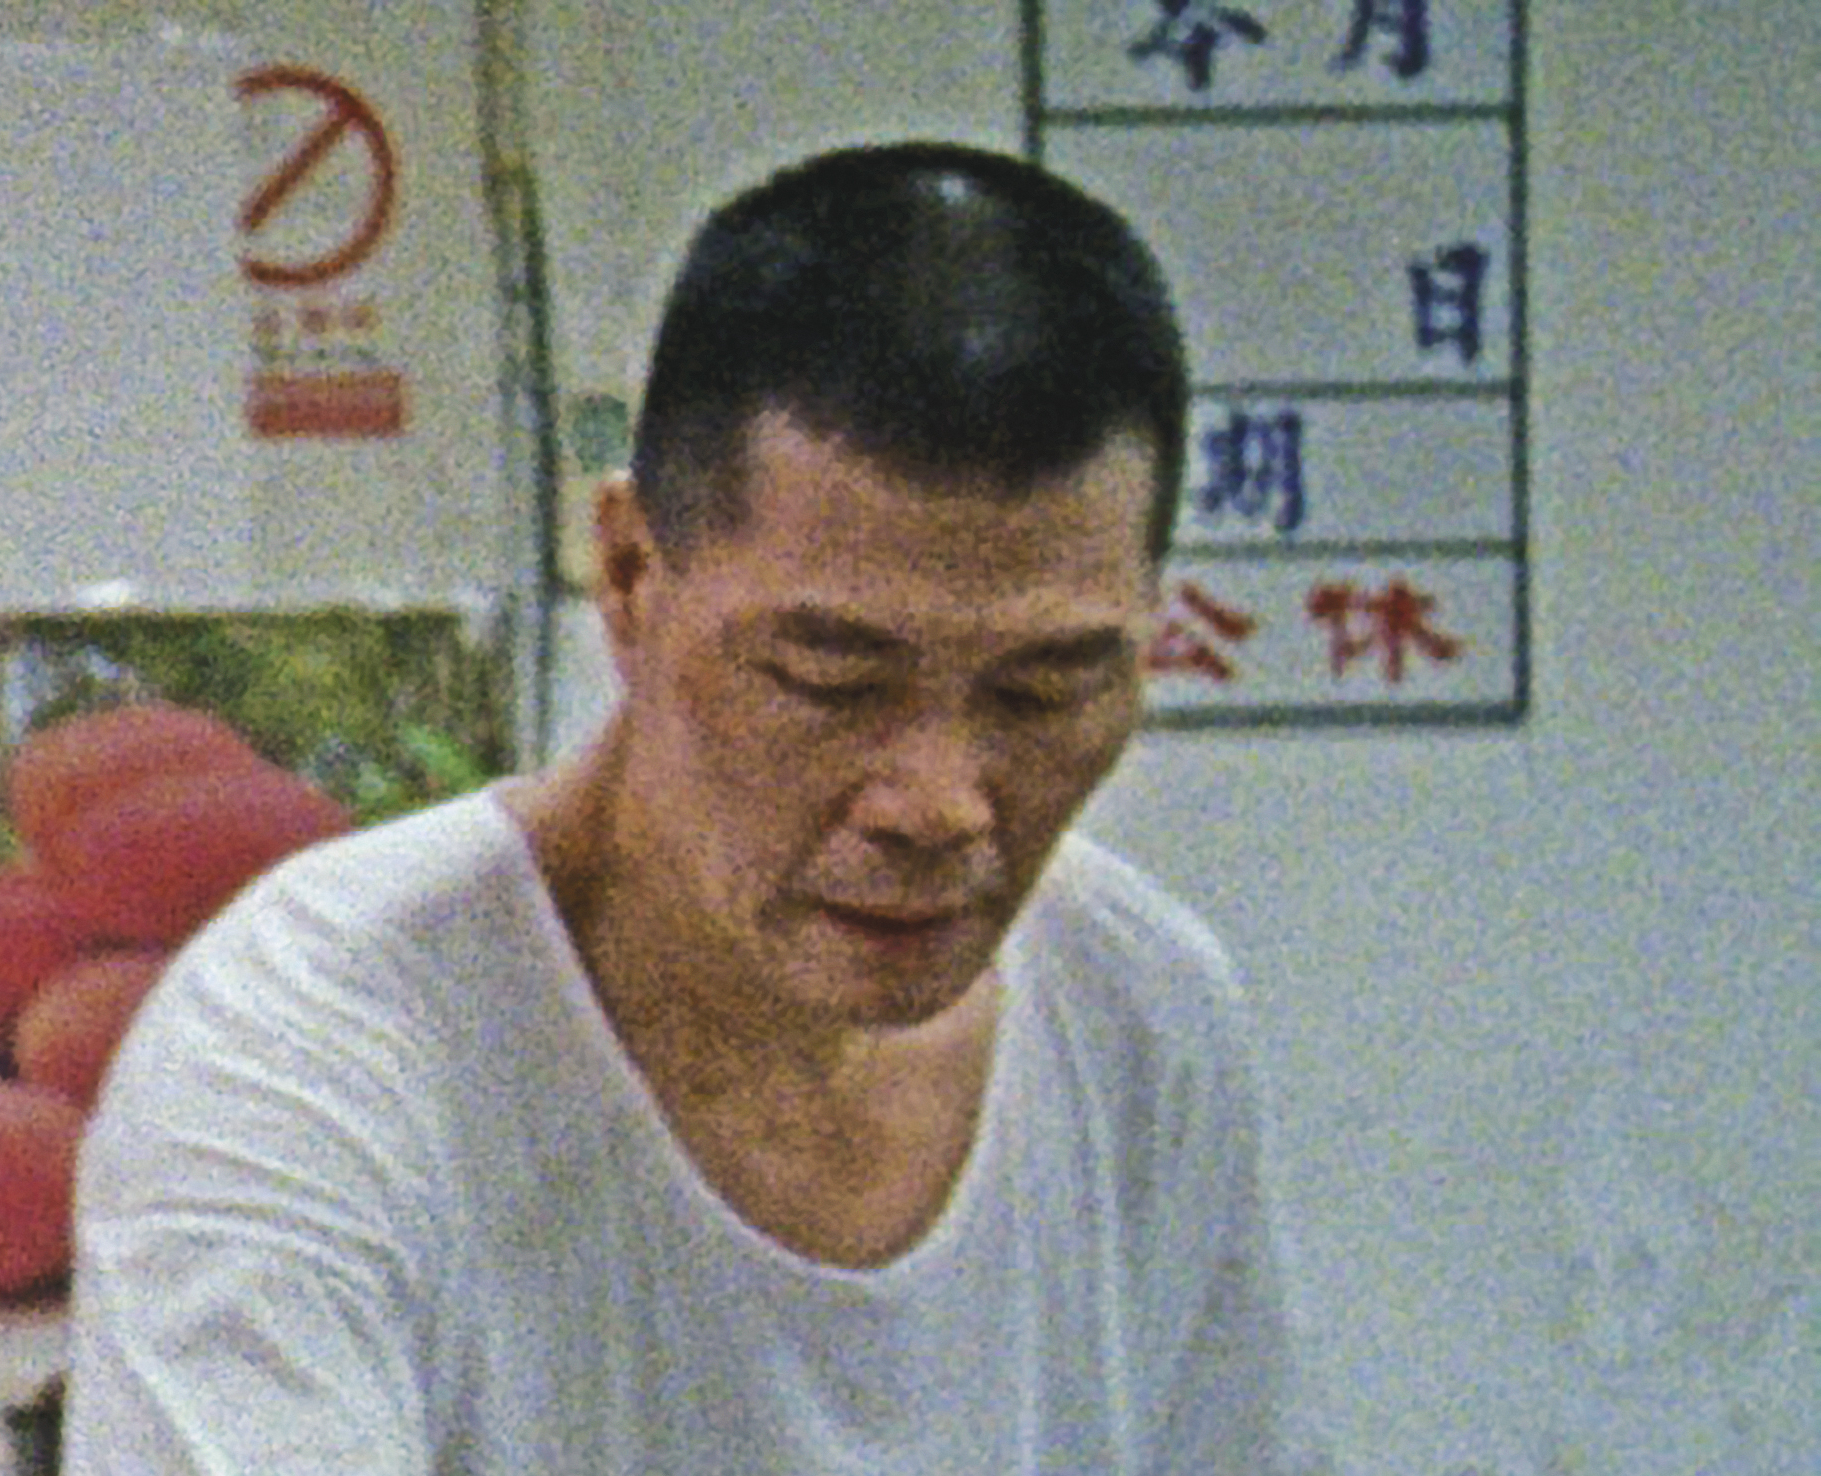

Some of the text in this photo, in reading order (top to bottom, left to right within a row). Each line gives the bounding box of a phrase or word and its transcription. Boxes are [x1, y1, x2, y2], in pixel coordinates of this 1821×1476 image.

[1406, 240, 1489, 364] 日
[1199, 407, 1305, 533] 期
[1139, 571, 1466, 684] 公休
